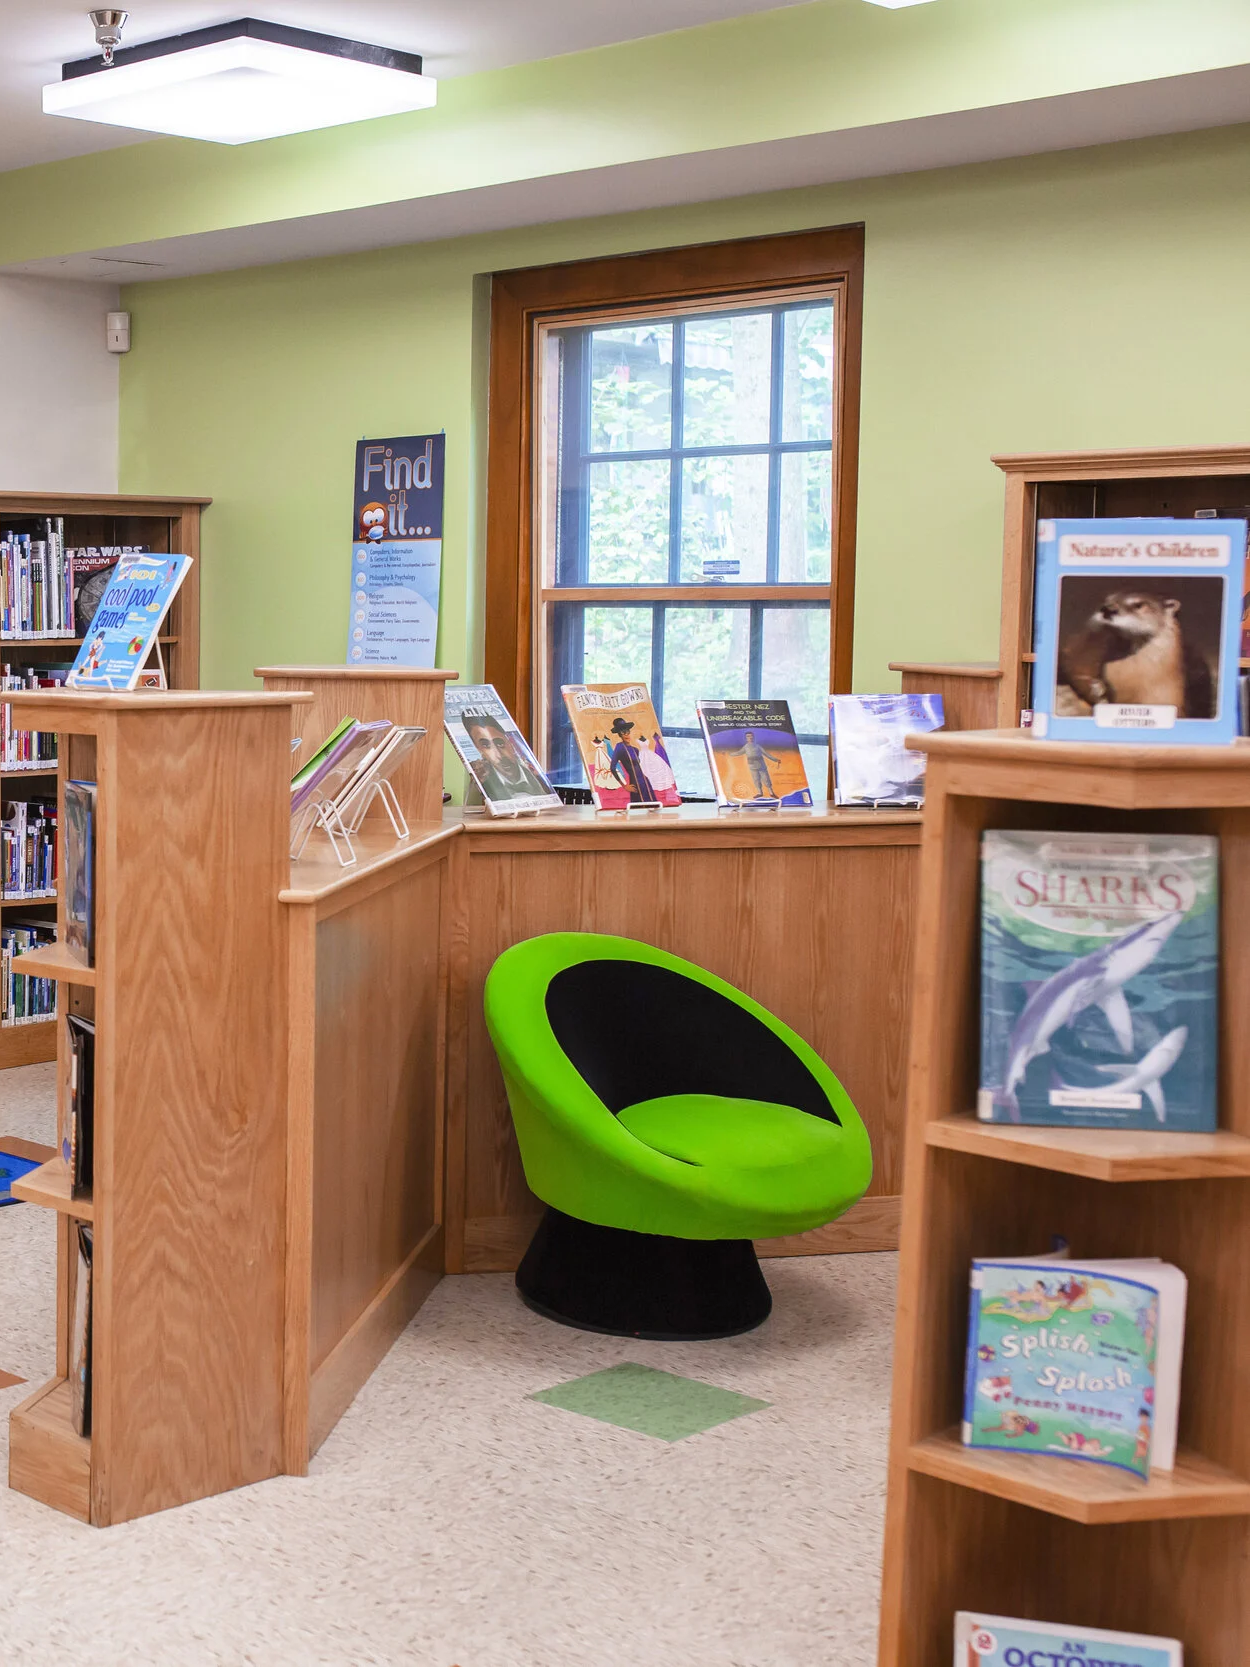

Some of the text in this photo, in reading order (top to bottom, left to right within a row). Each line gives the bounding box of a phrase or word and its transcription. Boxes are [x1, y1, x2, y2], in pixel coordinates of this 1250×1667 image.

[363, 439, 433, 491] Find
[64, 546, 142, 557] TAR WARS
[1069, 542, 1219, 558] Nature's Children
[130, 570, 158, 580] 101
[105, 582, 160, 611] cool pool
[92, 609, 129, 634] games
[444, 690, 494, 703] ETWEEN
[576, 688, 644, 708] FANCY PARTY GOWNS
[1014, 869, 1183, 912] SHARKS
[1036, 1366, 1132, 1396] Splash
[1013, 1395, 1061, 1412] Penny
[1003, 1647, 1146, 1667] OCTO
[1062, 1641, 1087, 1655] AN
